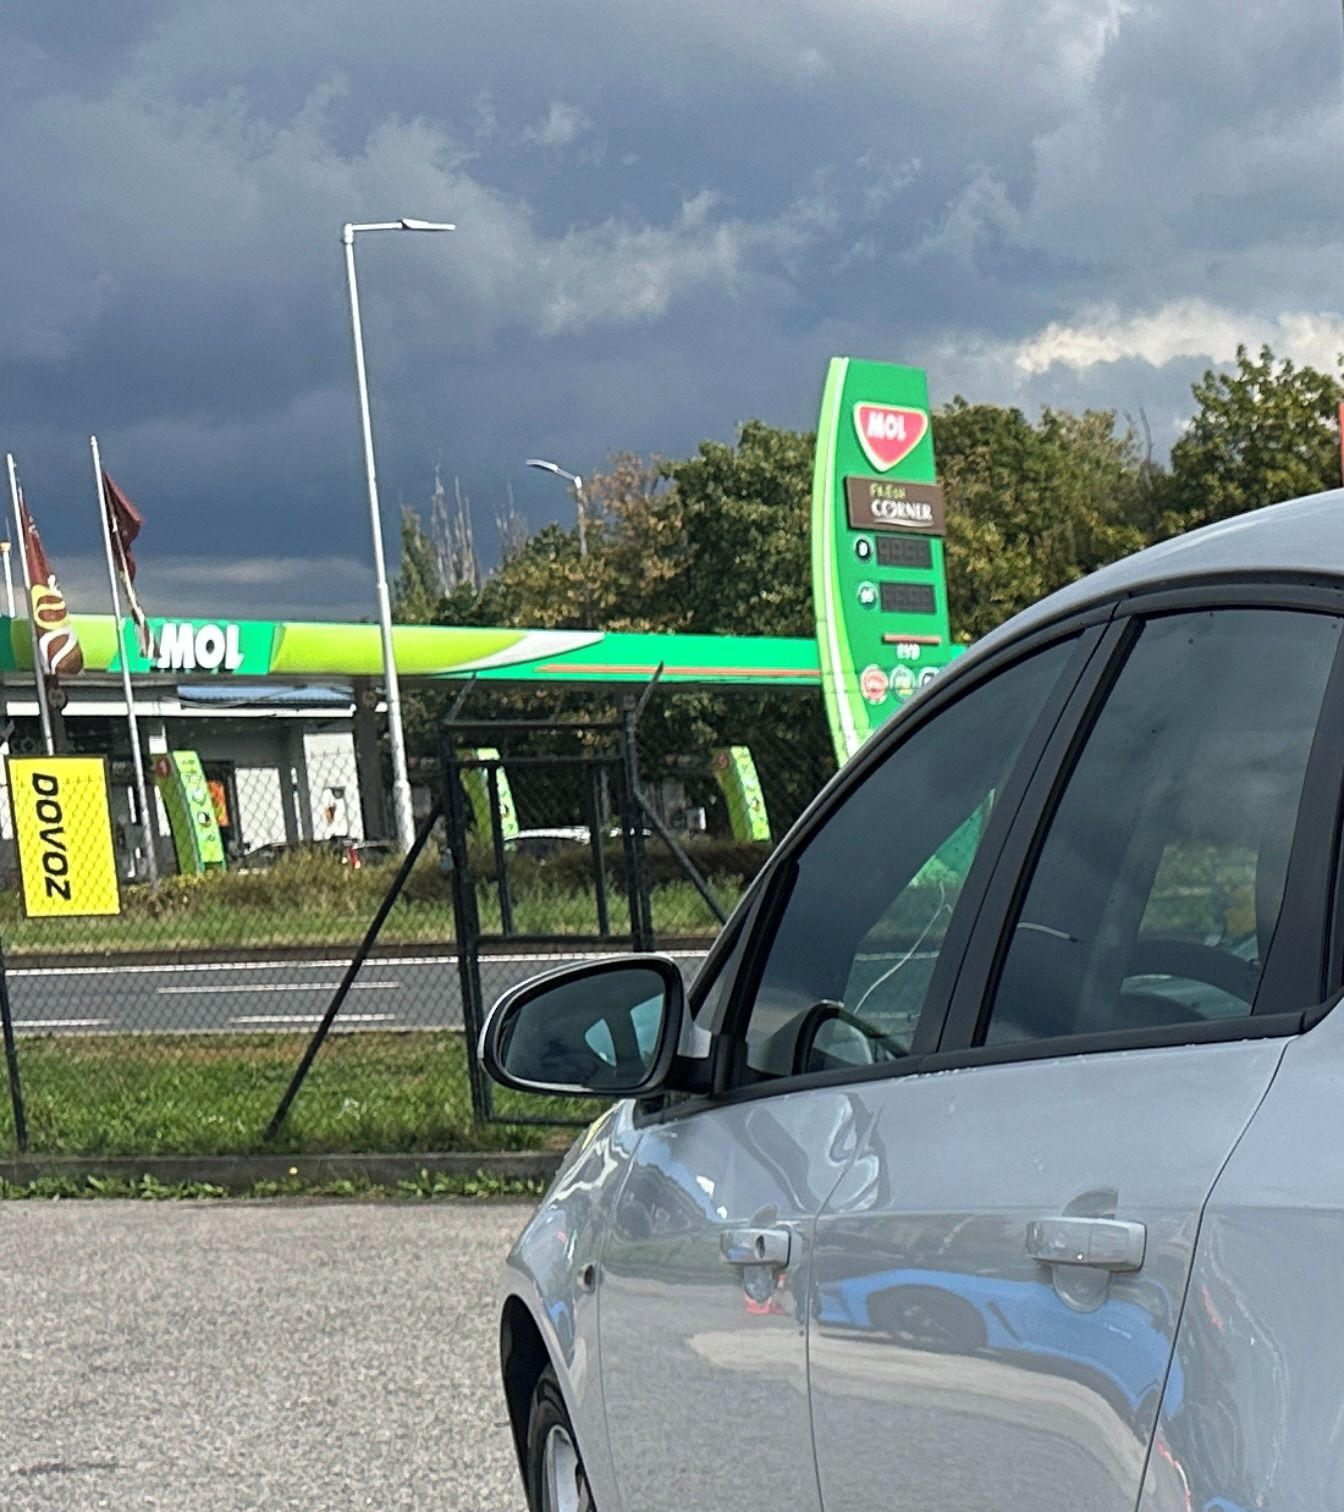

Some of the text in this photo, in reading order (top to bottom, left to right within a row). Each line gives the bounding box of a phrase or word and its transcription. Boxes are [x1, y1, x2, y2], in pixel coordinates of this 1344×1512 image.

[866, 411, 907, 441] MOL
[871, 499, 933, 521] CORNER
[157, 622, 245, 669] MOL
[32, 772, 71, 901] DOVOZ
